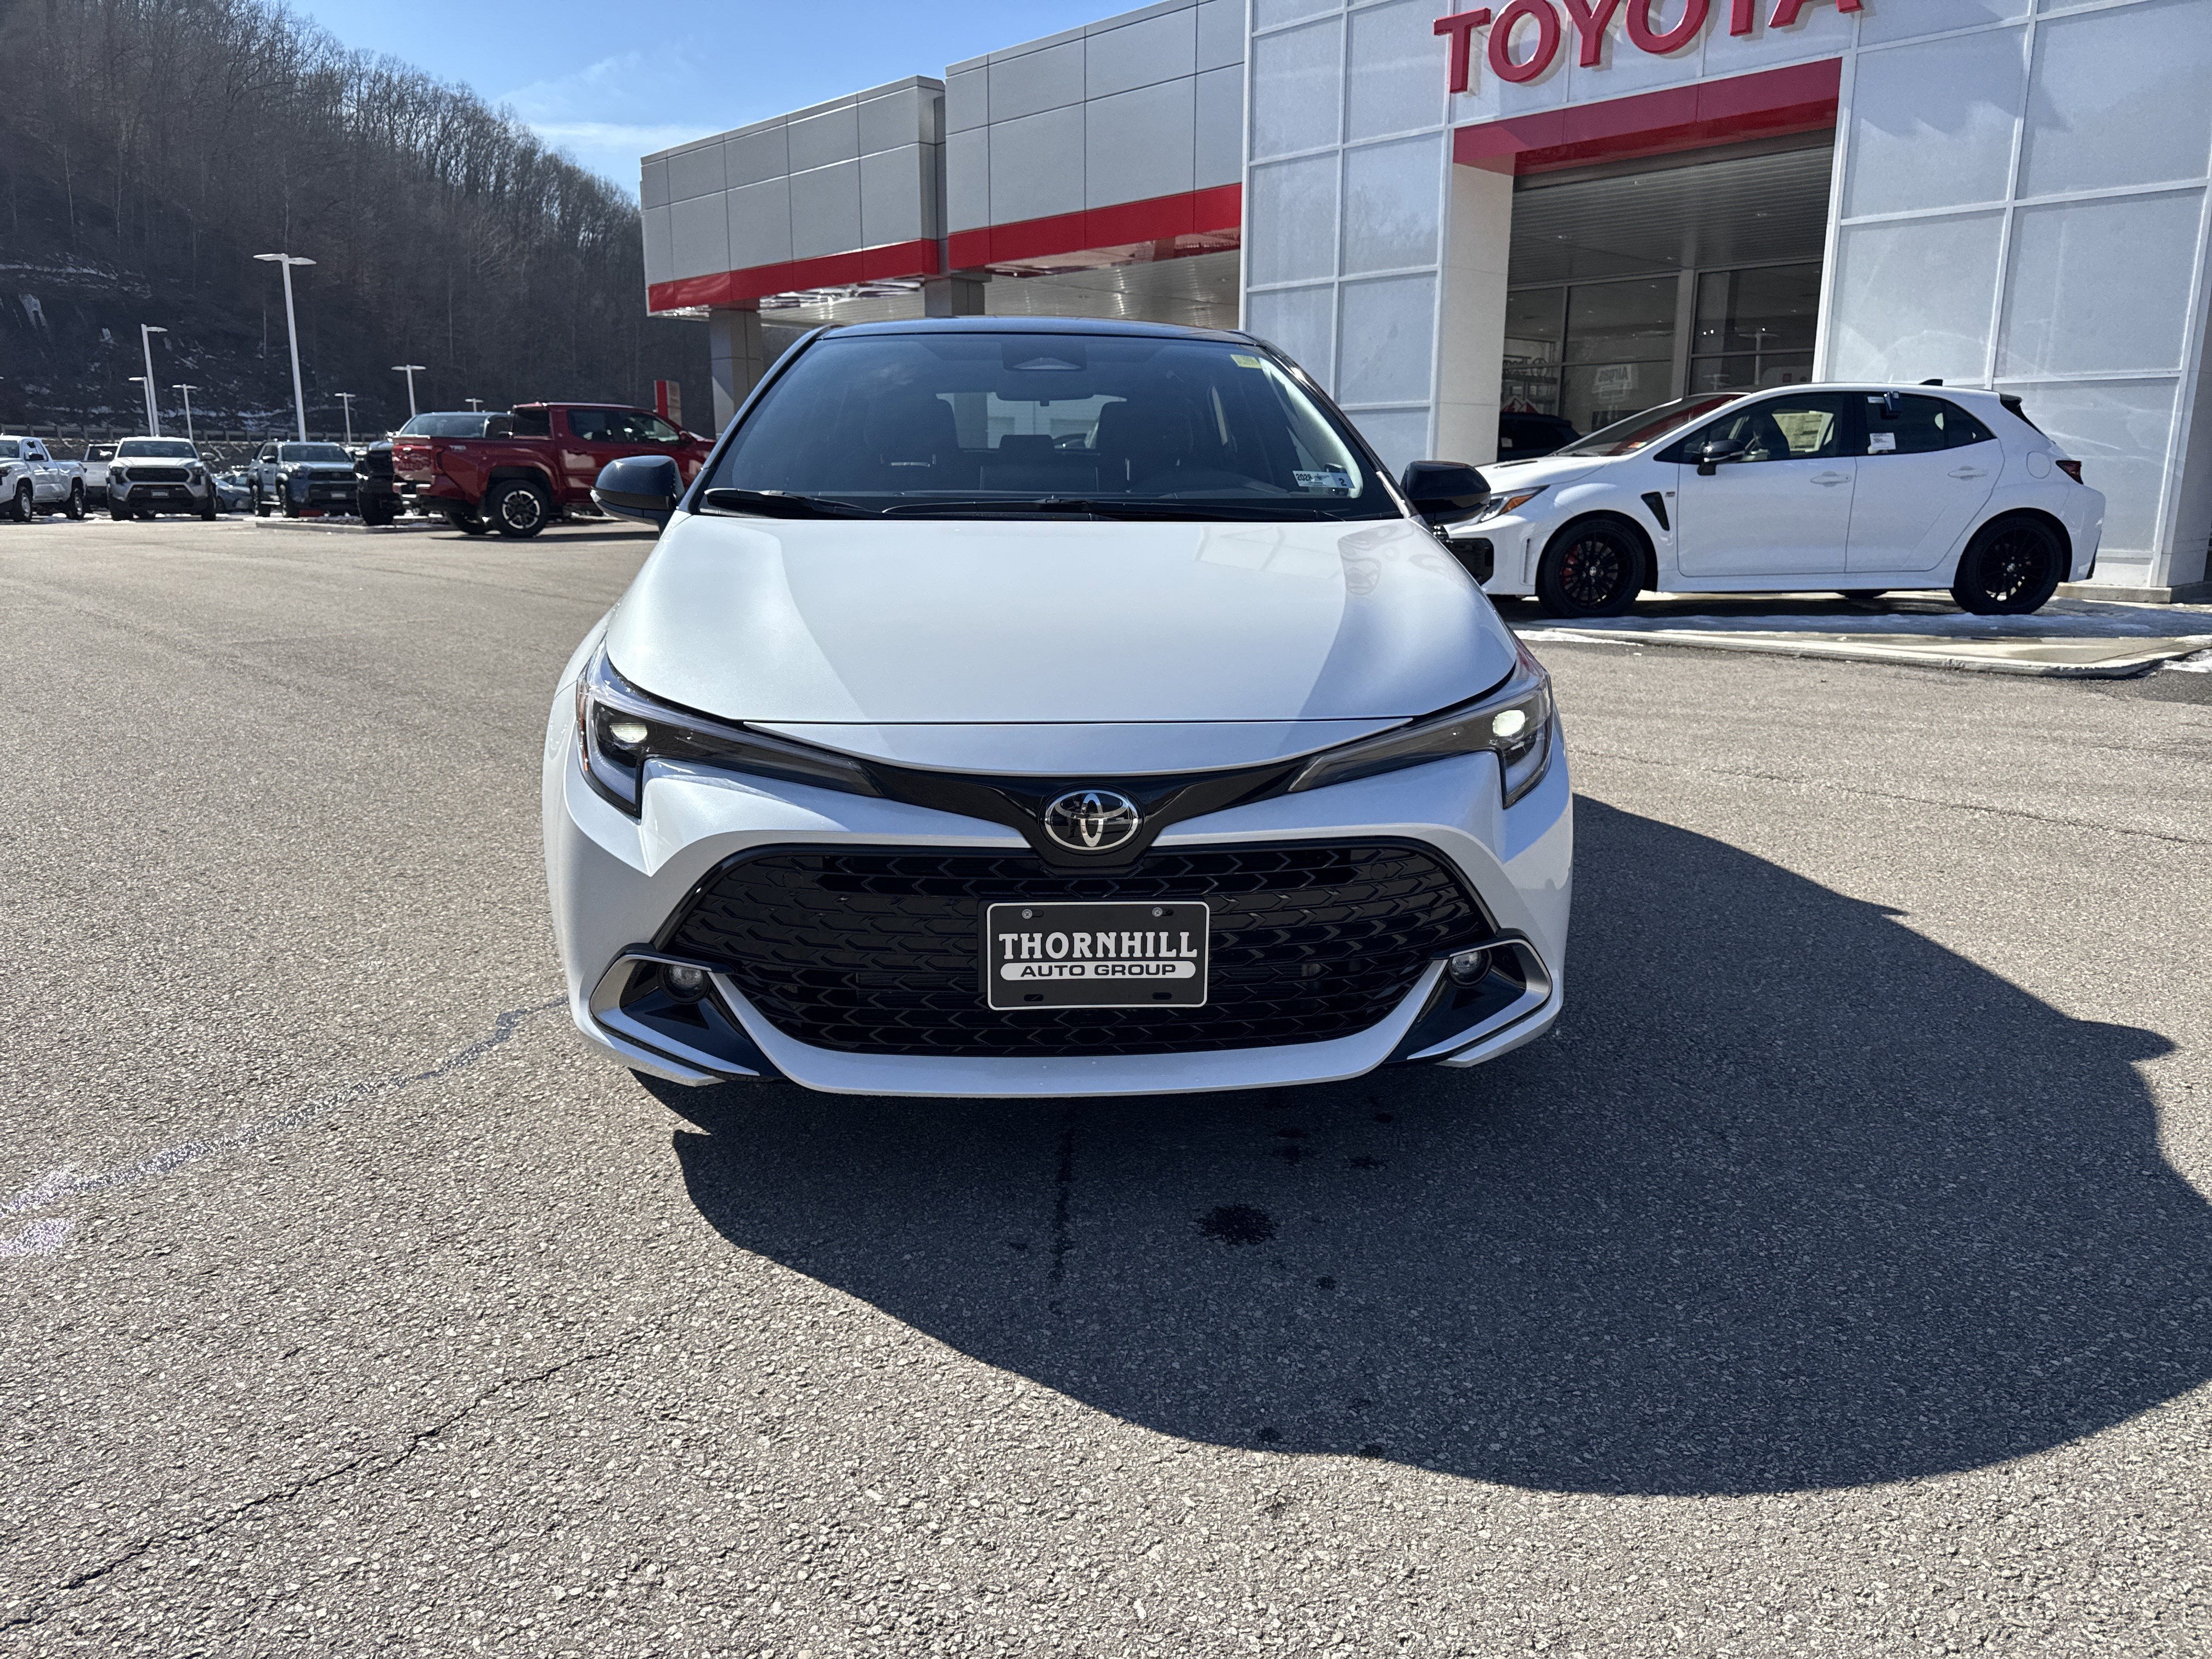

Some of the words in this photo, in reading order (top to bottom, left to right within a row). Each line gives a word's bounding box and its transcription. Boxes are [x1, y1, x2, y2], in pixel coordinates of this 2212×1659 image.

[1434, 0, 1863, 94] TOYO
[1338, 477, 1347, 487] 2
[998, 932, 1198, 960] THORNHILL
[1020, 964, 1086, 977] AUTO
[1094, 963, 1176, 976] GROUP
